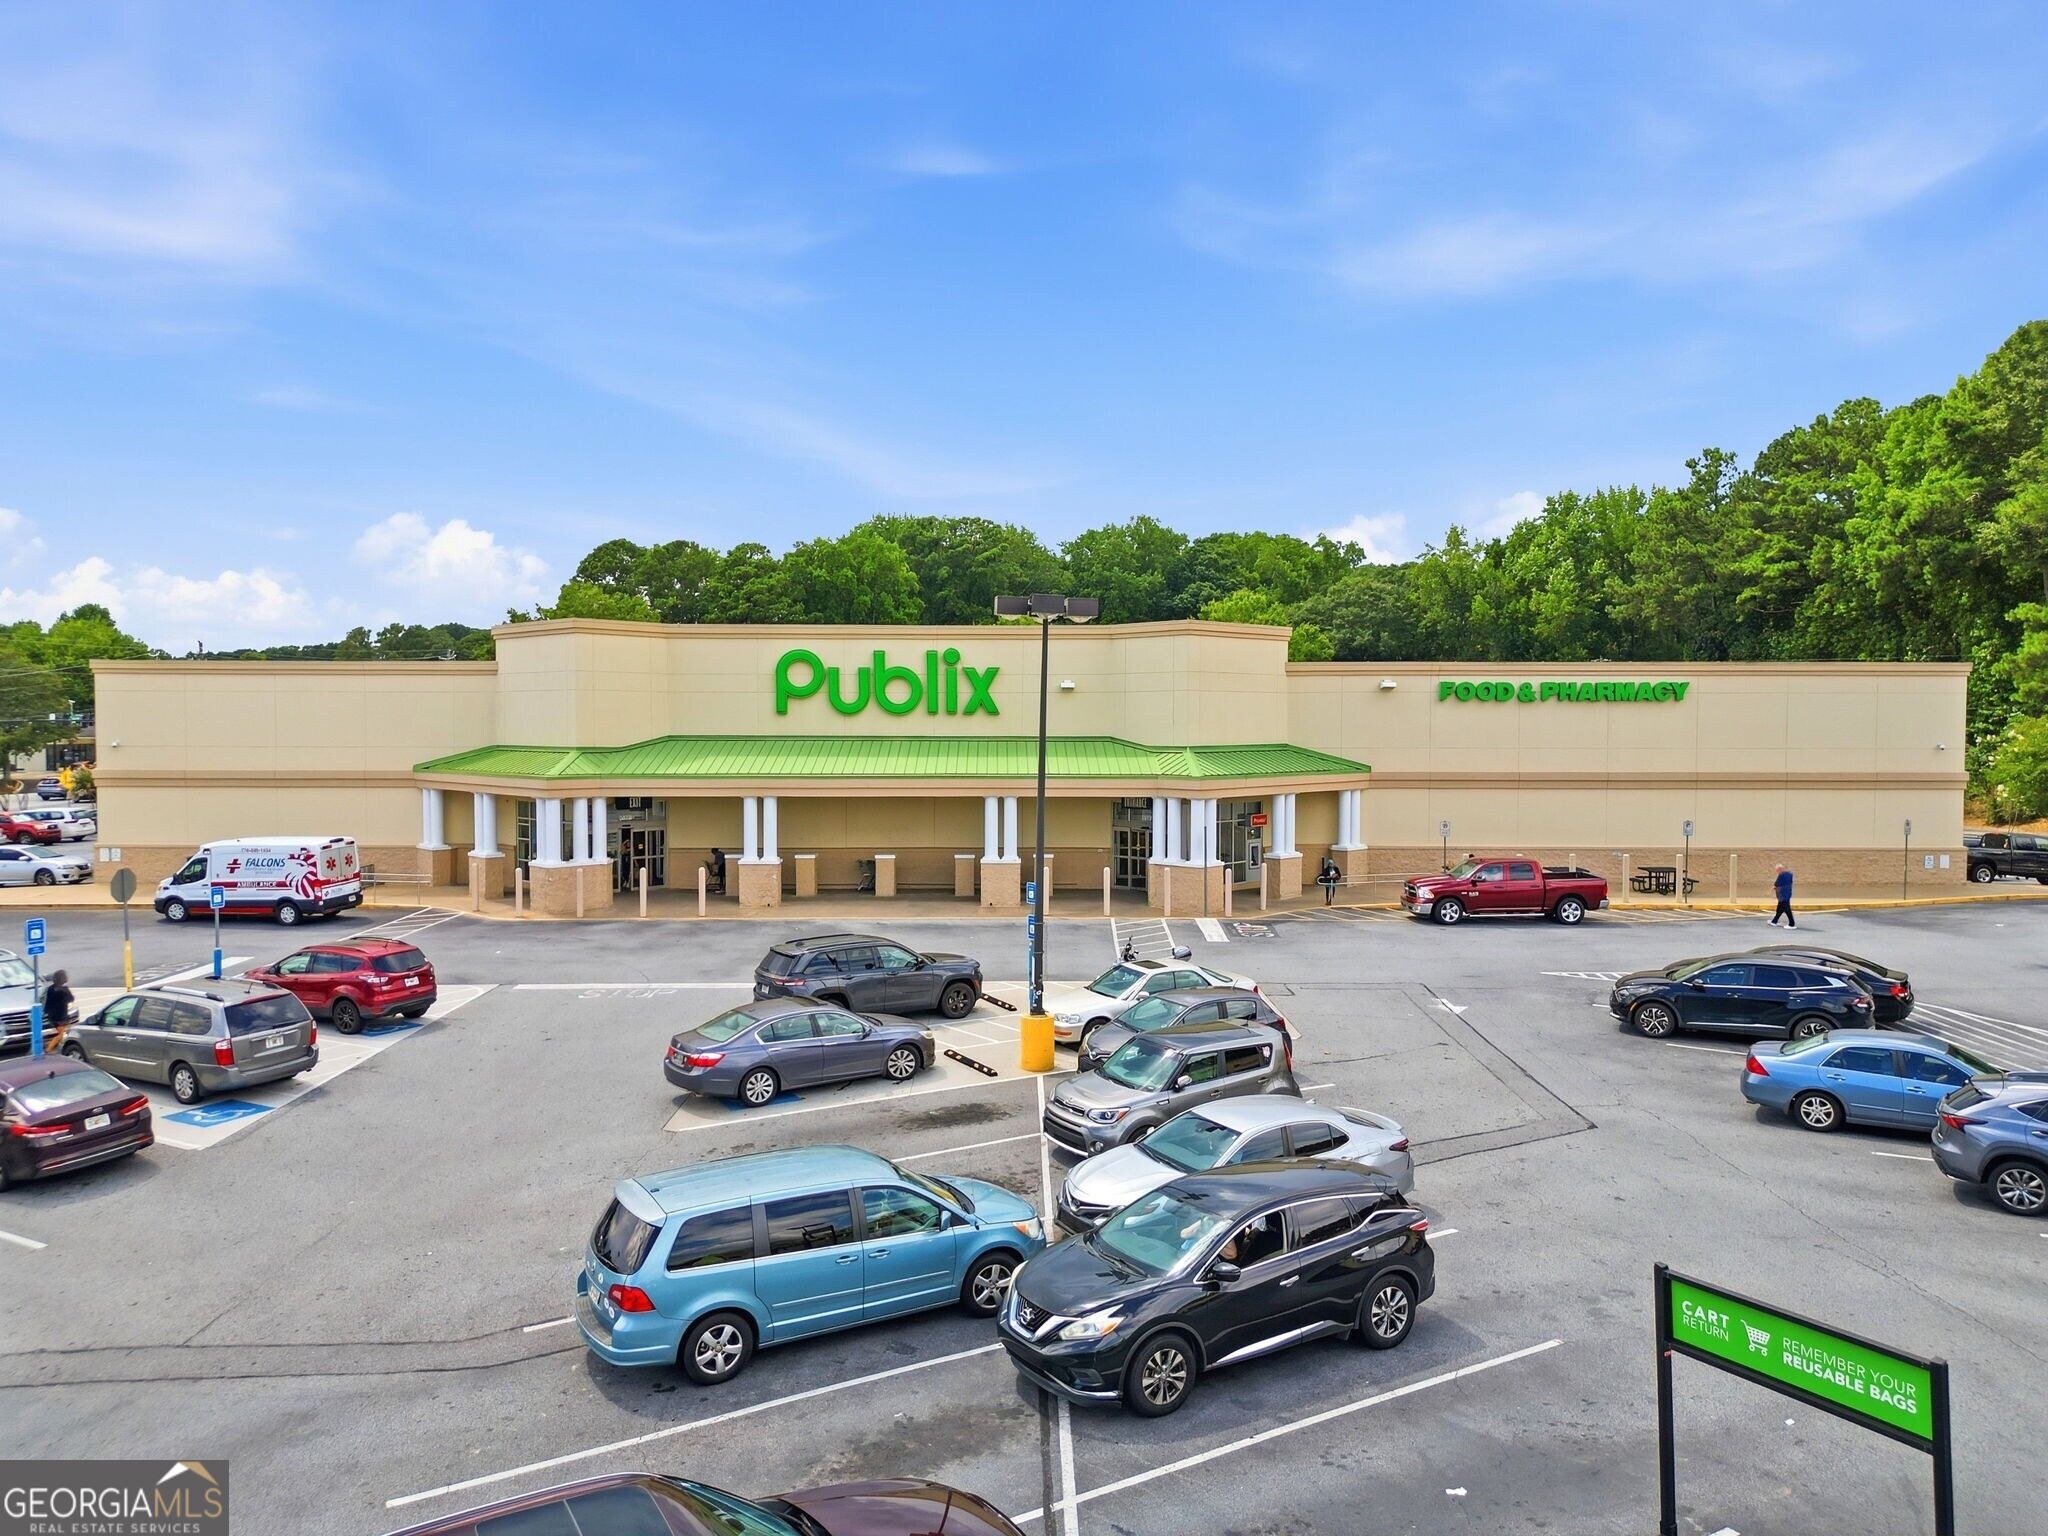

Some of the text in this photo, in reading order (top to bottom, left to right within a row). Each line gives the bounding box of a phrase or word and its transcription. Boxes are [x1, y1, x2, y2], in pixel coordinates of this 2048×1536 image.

[775, 647, 1001, 716] Publix
[1439, 681, 1690, 702] FOOD & PHARMACY
[629, 796, 641, 808] EXIT
[245, 857, 286, 868] FALCONS
[1681, 1300, 1730, 1329] CART
[1682, 1315, 1729, 1342] RETURN
[1782, 1337, 1917, 1398] REMEMBER YOUR
[1782, 1351, 1918, 1415] REUSABLE BAGS
